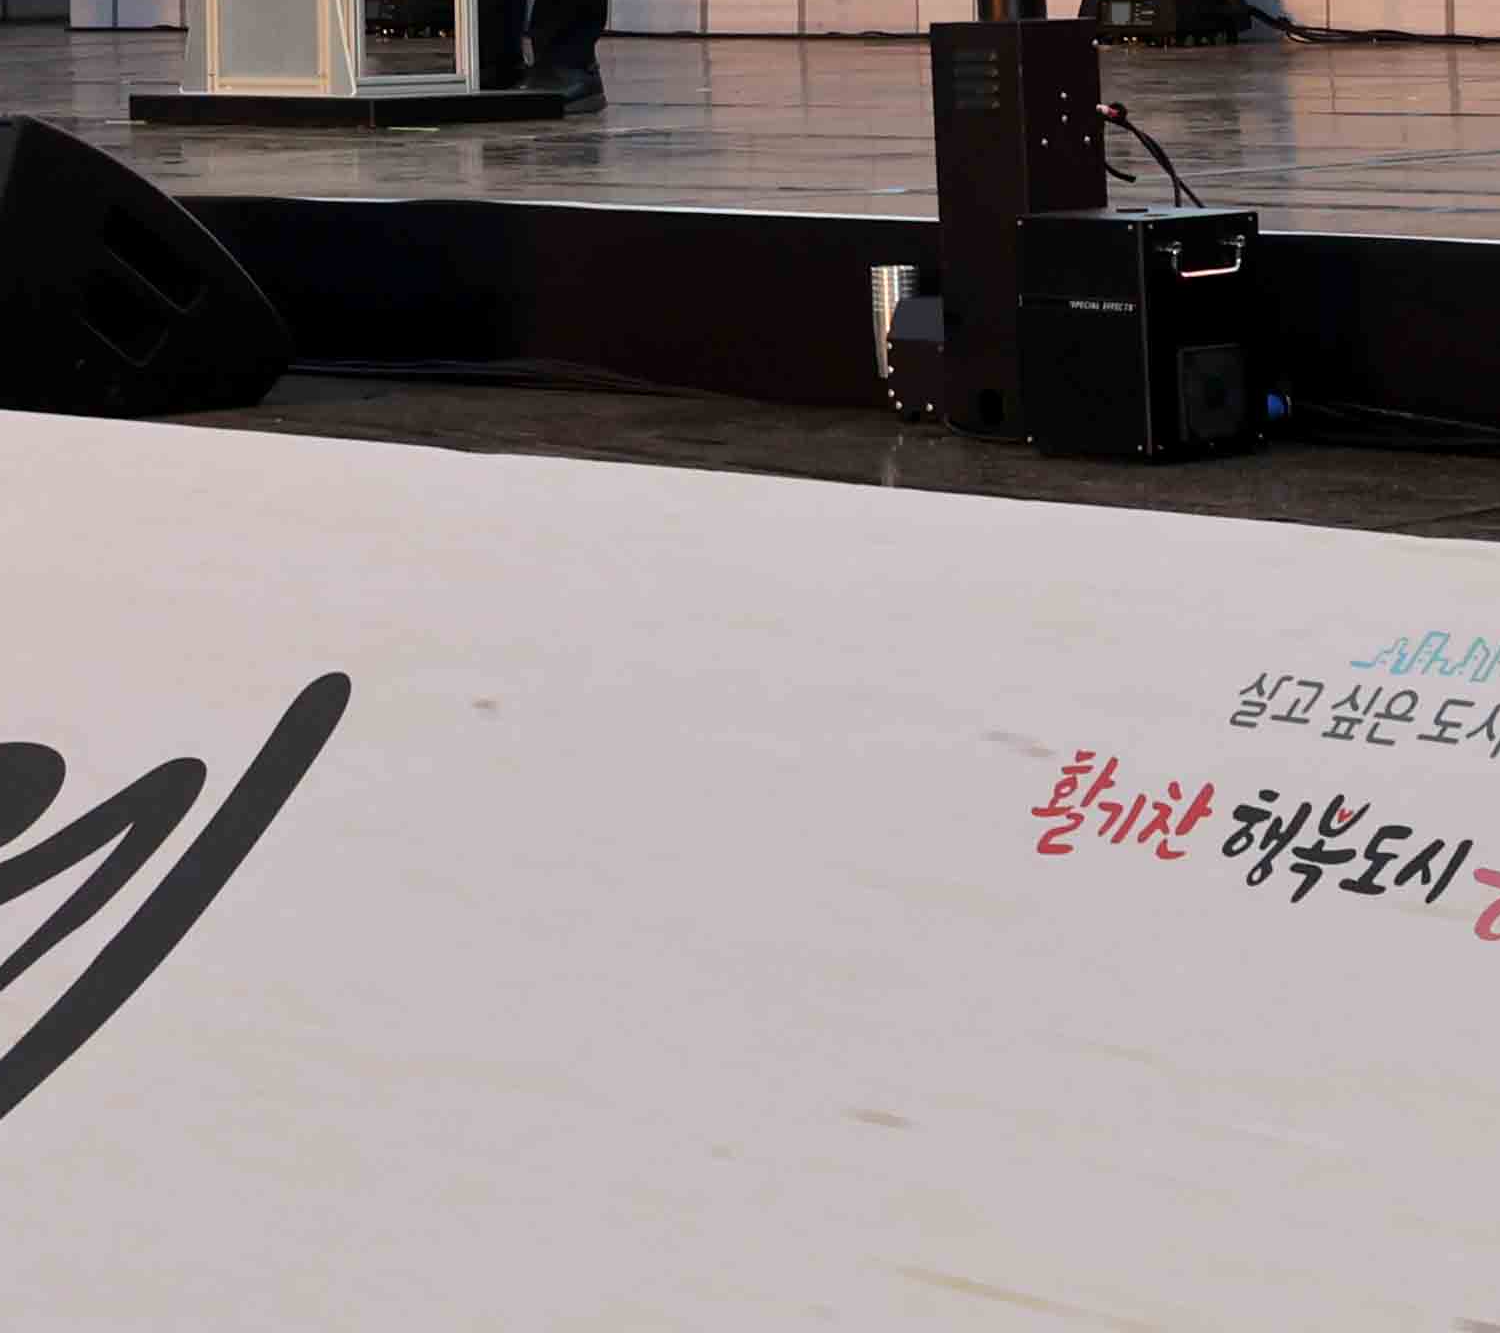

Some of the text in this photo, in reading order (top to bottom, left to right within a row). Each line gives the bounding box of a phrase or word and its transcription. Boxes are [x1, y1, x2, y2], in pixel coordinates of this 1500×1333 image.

[1229, 672, 1325, 729] 살고
[1321, 684, 1421, 748] 싶은
[1030, 750, 1214, 860] 활기찬
[1221, 789, 1475, 905] 행복도시
